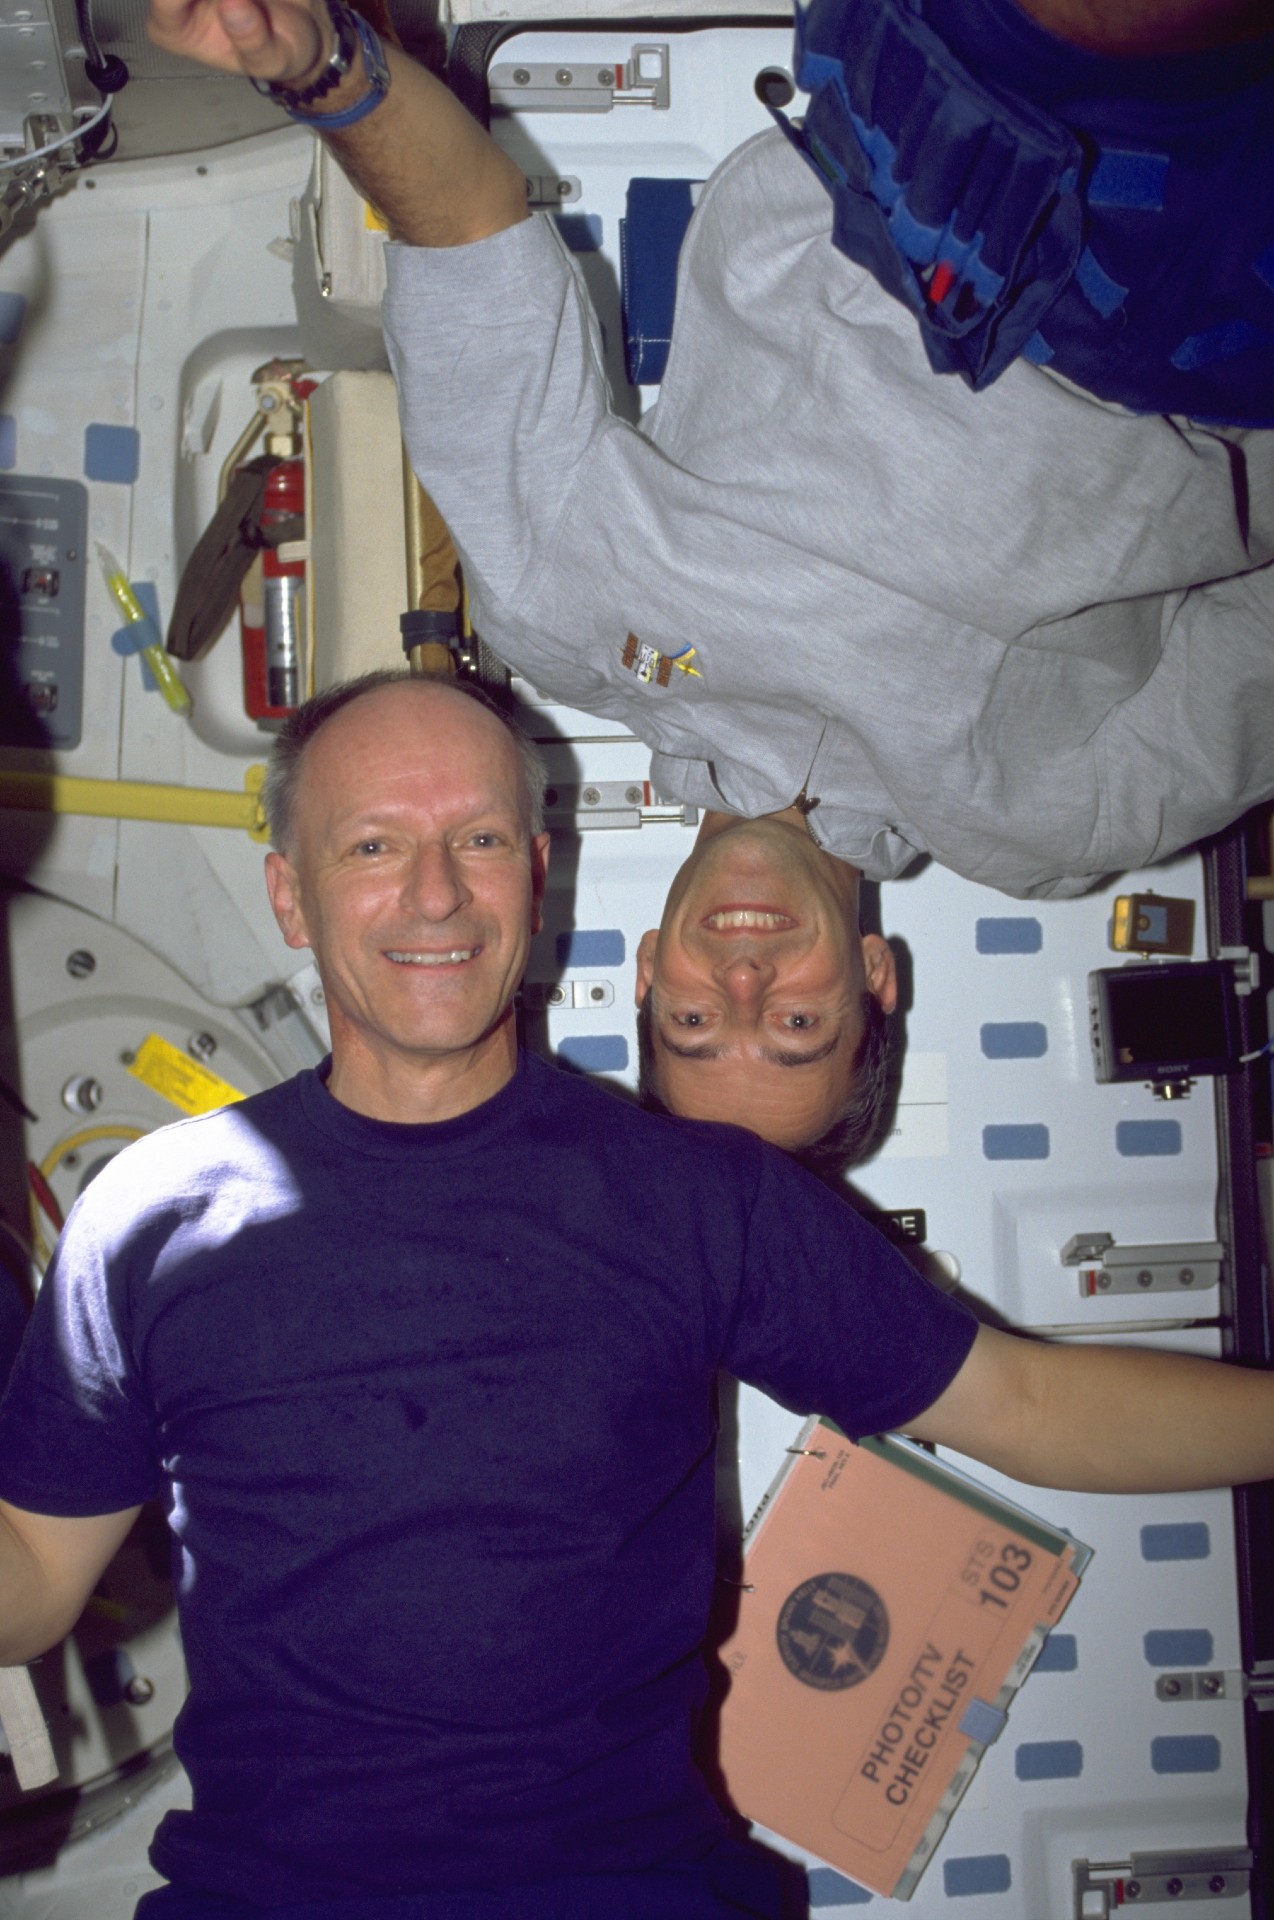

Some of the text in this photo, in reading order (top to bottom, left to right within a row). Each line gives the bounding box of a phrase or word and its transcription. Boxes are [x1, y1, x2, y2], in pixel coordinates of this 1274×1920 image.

[1157, 1064, 1190, 1075] SONY
[961, 1540, 994, 1586] STS
[980, 1543, 1032, 1609] 103
[860, 1642, 942, 1783] PHOTO/TV
[885, 1648, 975, 1805] CHECKLIST
